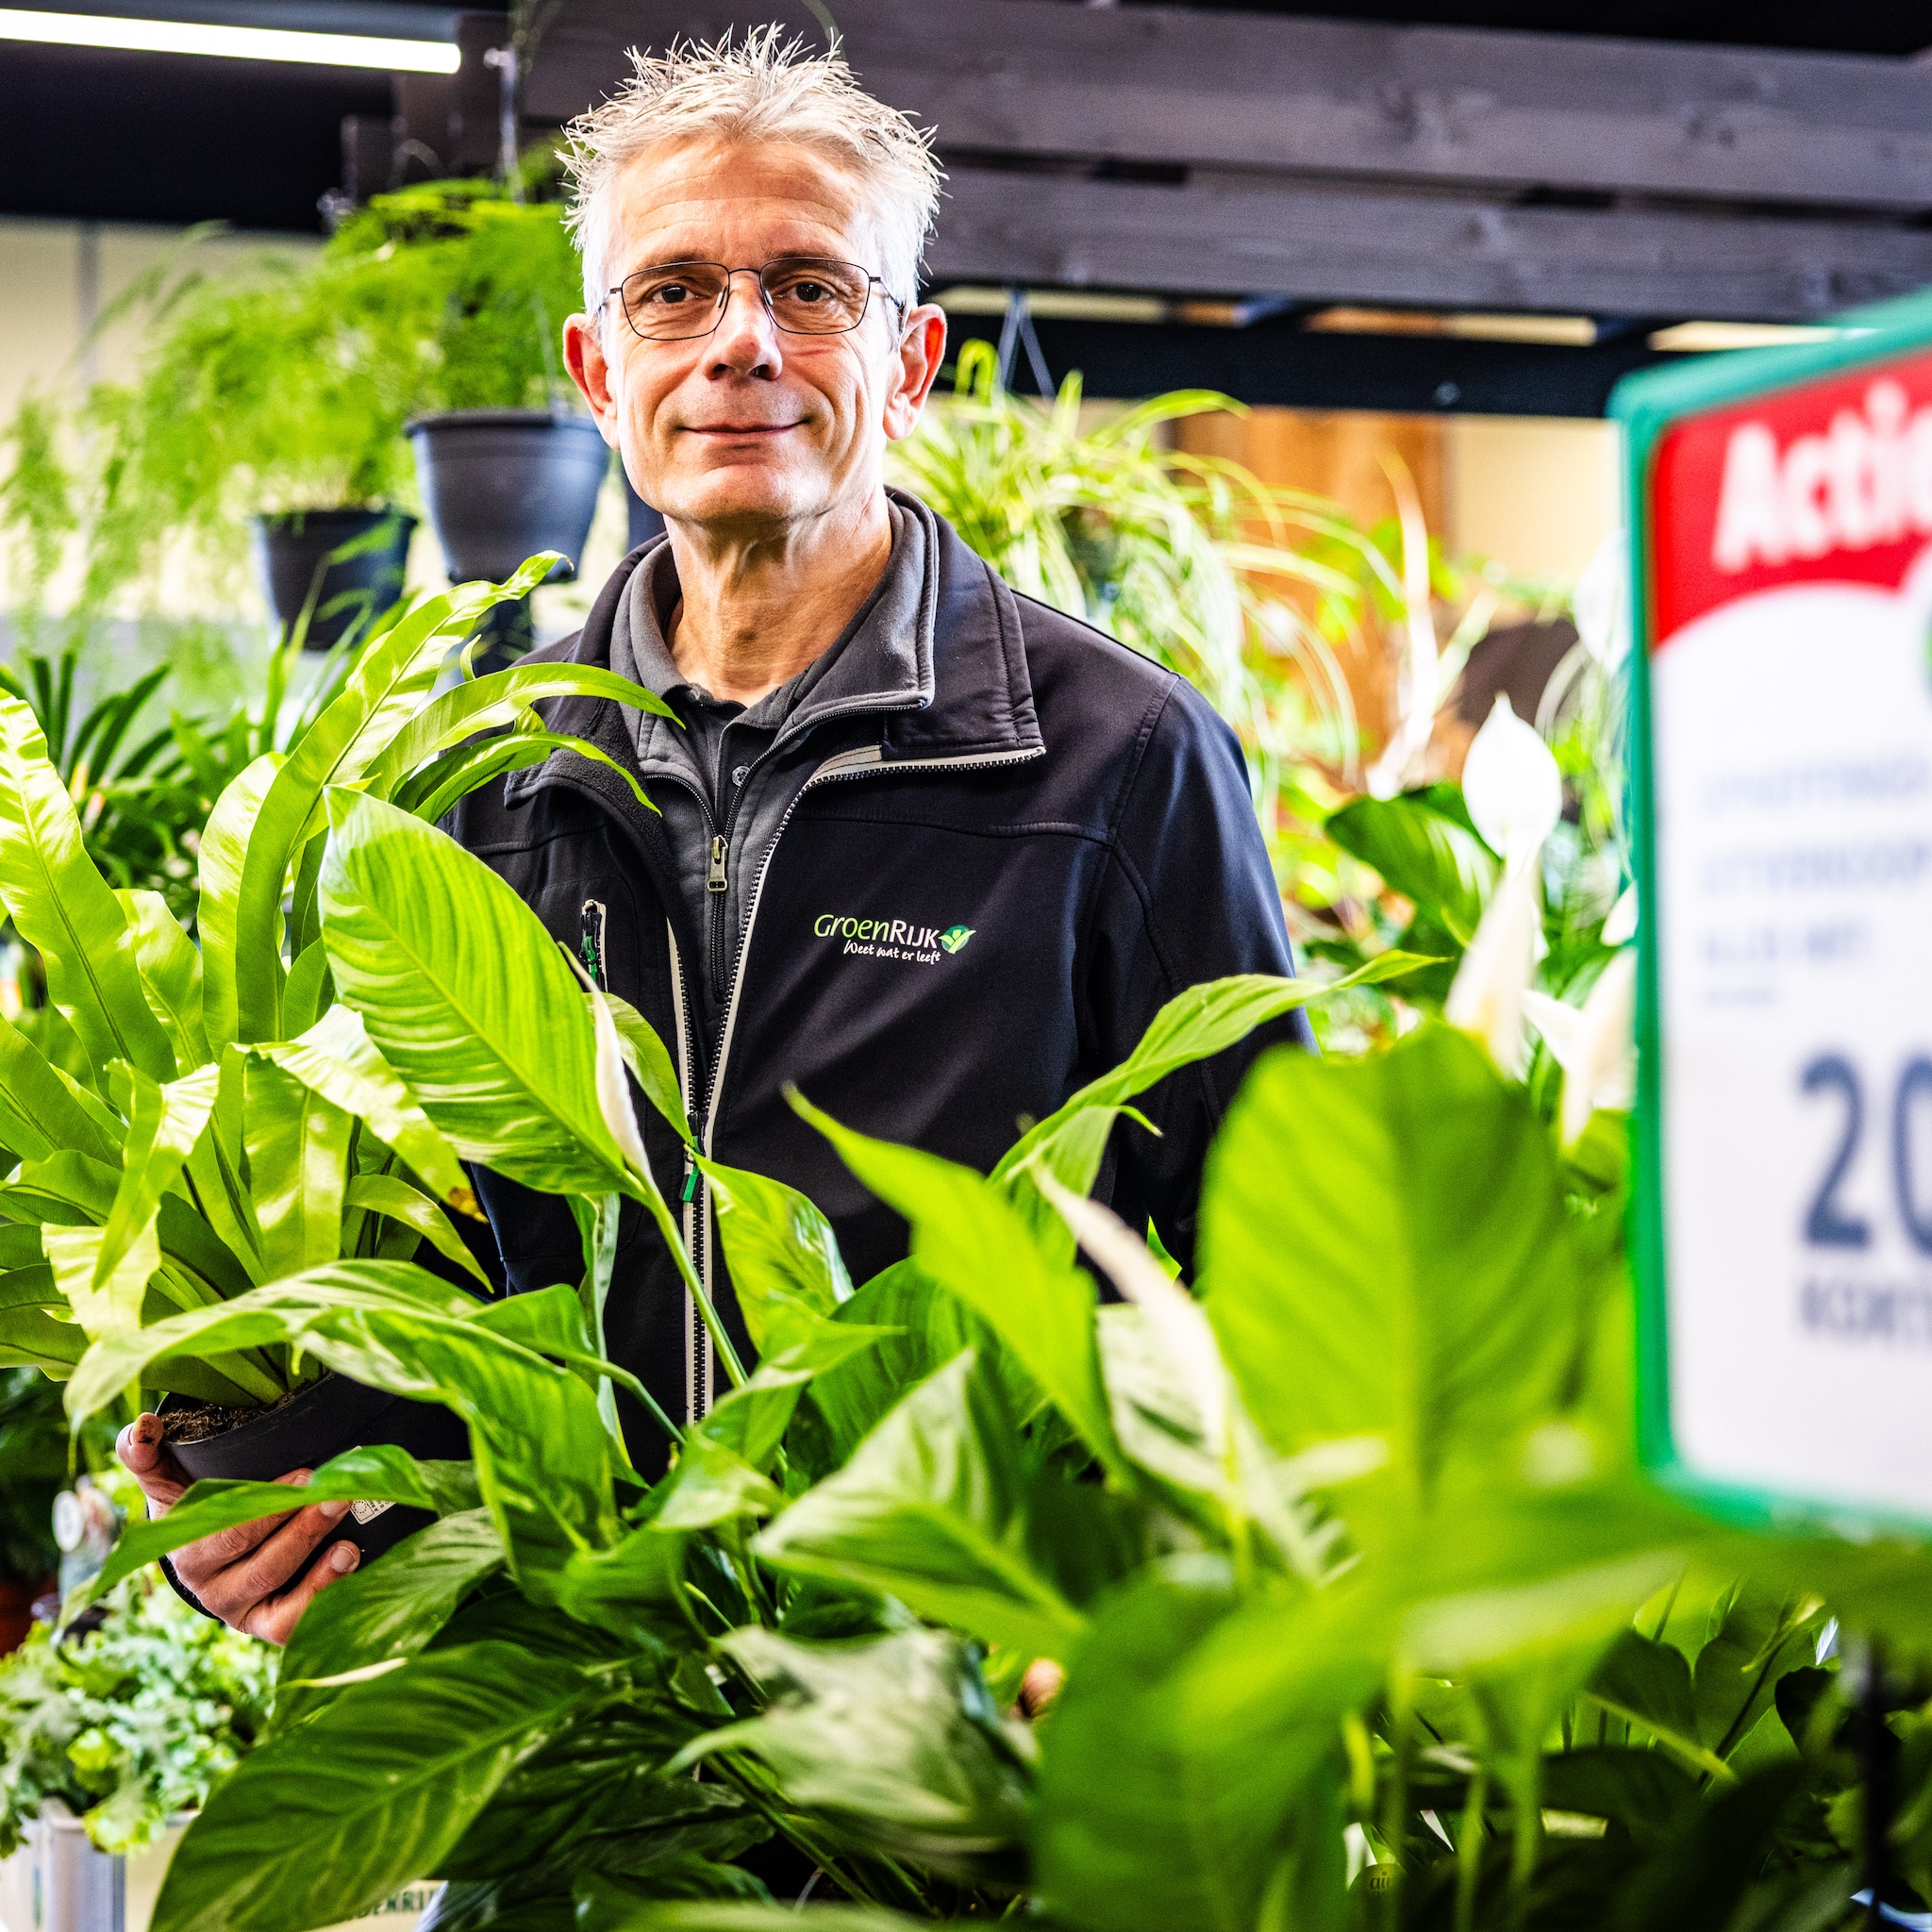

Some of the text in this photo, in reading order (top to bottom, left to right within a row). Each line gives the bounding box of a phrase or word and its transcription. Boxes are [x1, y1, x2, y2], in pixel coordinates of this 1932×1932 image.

[813, 913, 941, 949] GroenRIJK
[842, 939, 941, 965] Weet wat er leeft
